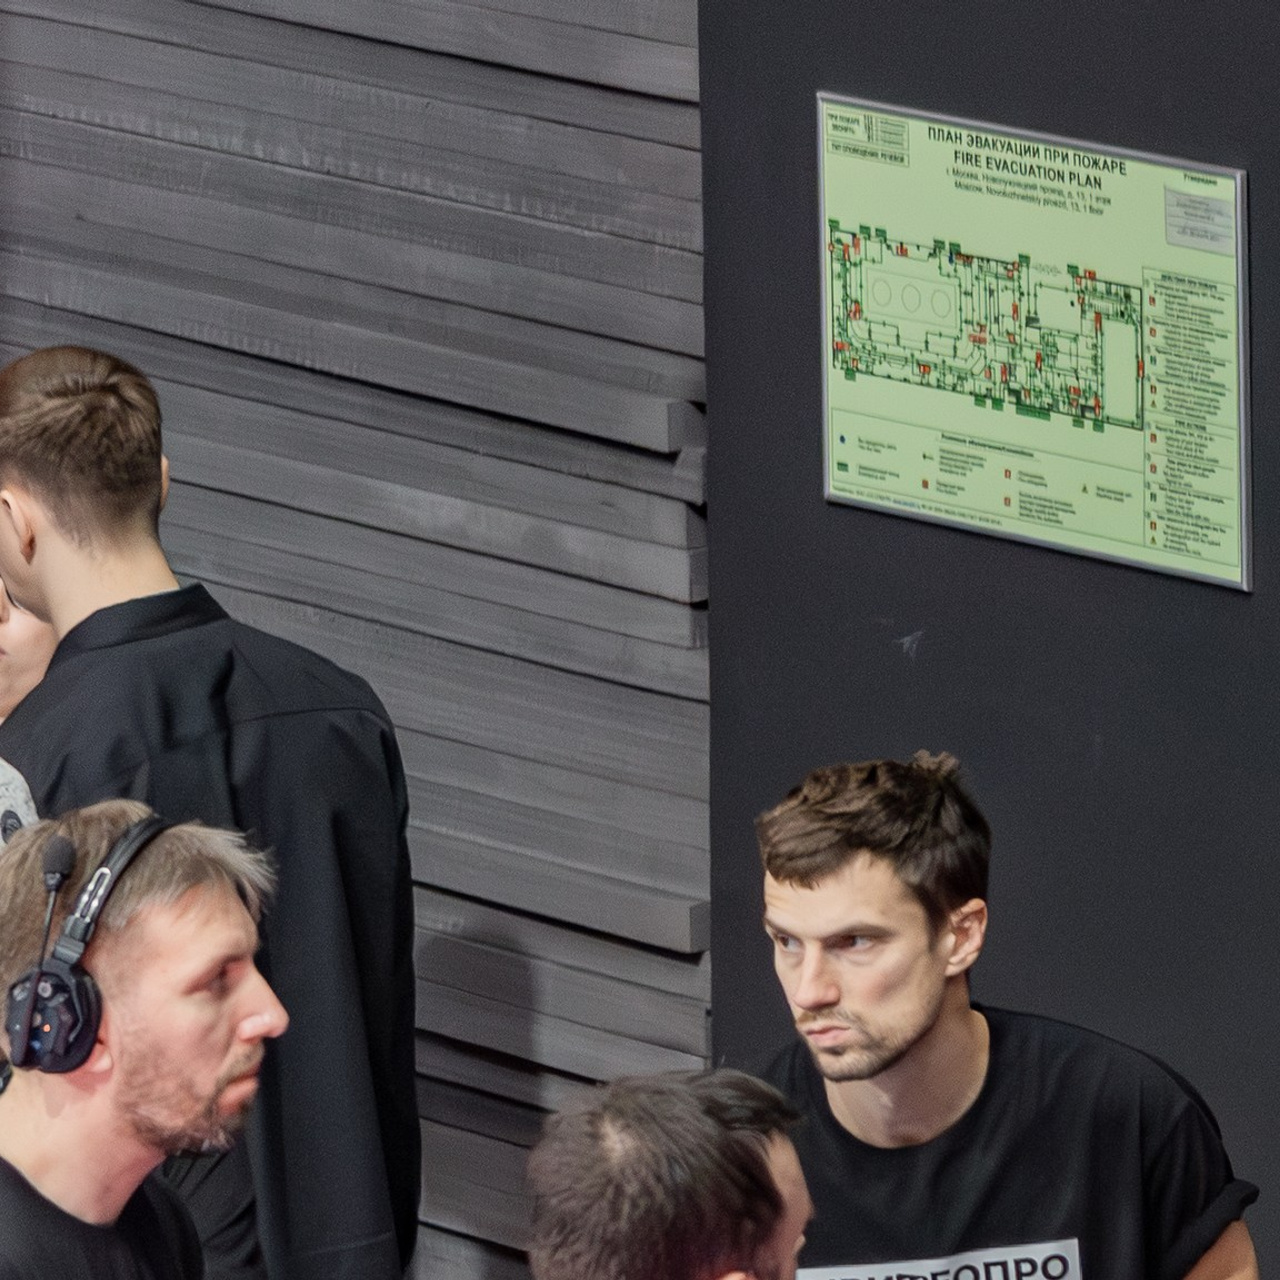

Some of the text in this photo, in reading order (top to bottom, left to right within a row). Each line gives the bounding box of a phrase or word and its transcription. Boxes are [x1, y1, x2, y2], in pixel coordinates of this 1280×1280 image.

[928, 126, 962, 144] ПЛАН
[967, 134, 1040, 159] ЭВАКУАЦИИ
[1045, 148, 1069, 165] ПРИ
[1073, 153, 1127, 176] ПОЖАРЕ
[954, 150, 1102, 190] FIRE EVACUATION PLAN
